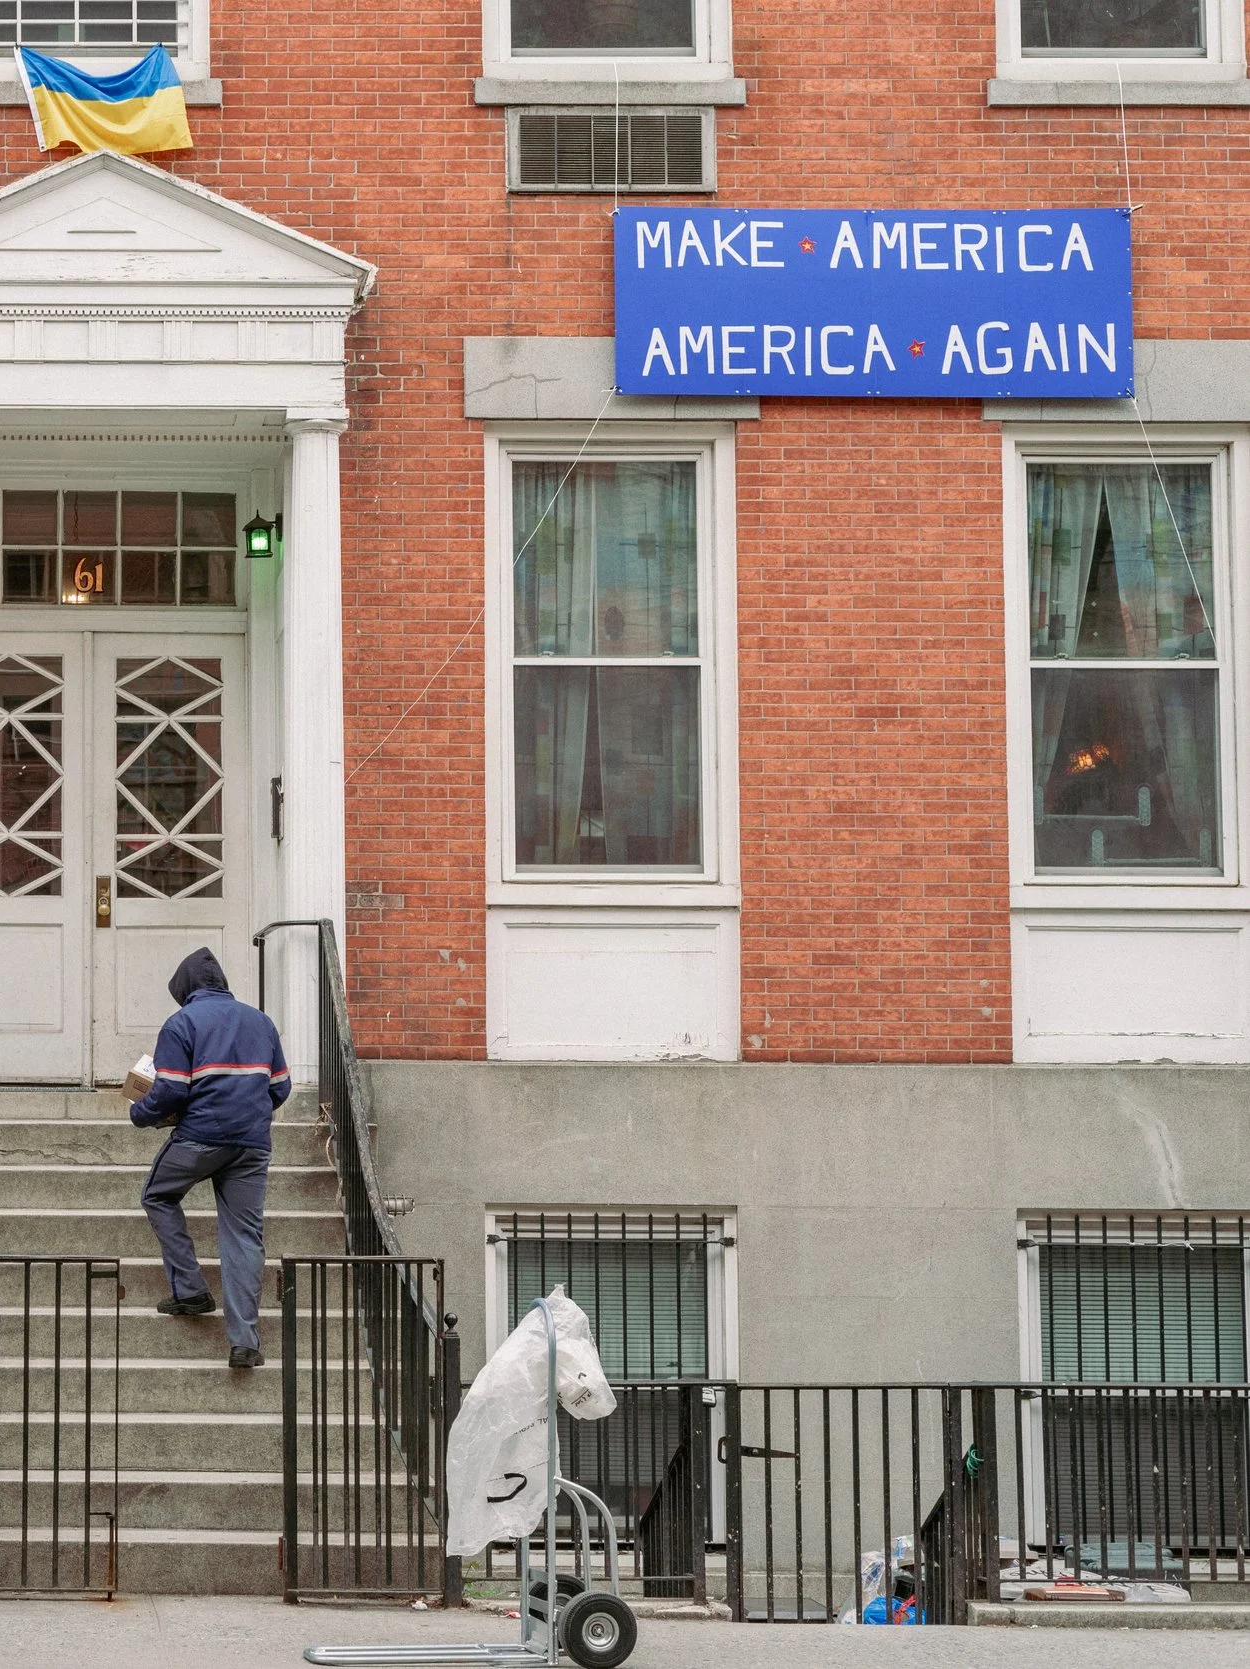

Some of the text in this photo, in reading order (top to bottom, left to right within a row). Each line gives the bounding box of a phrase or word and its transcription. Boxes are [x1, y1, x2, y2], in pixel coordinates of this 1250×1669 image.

[636, 220, 1094, 274] MAKE AMERICA
[642, 321, 1116, 377] AMERICA AGAIN
[73, 557, 104, 593] 61
